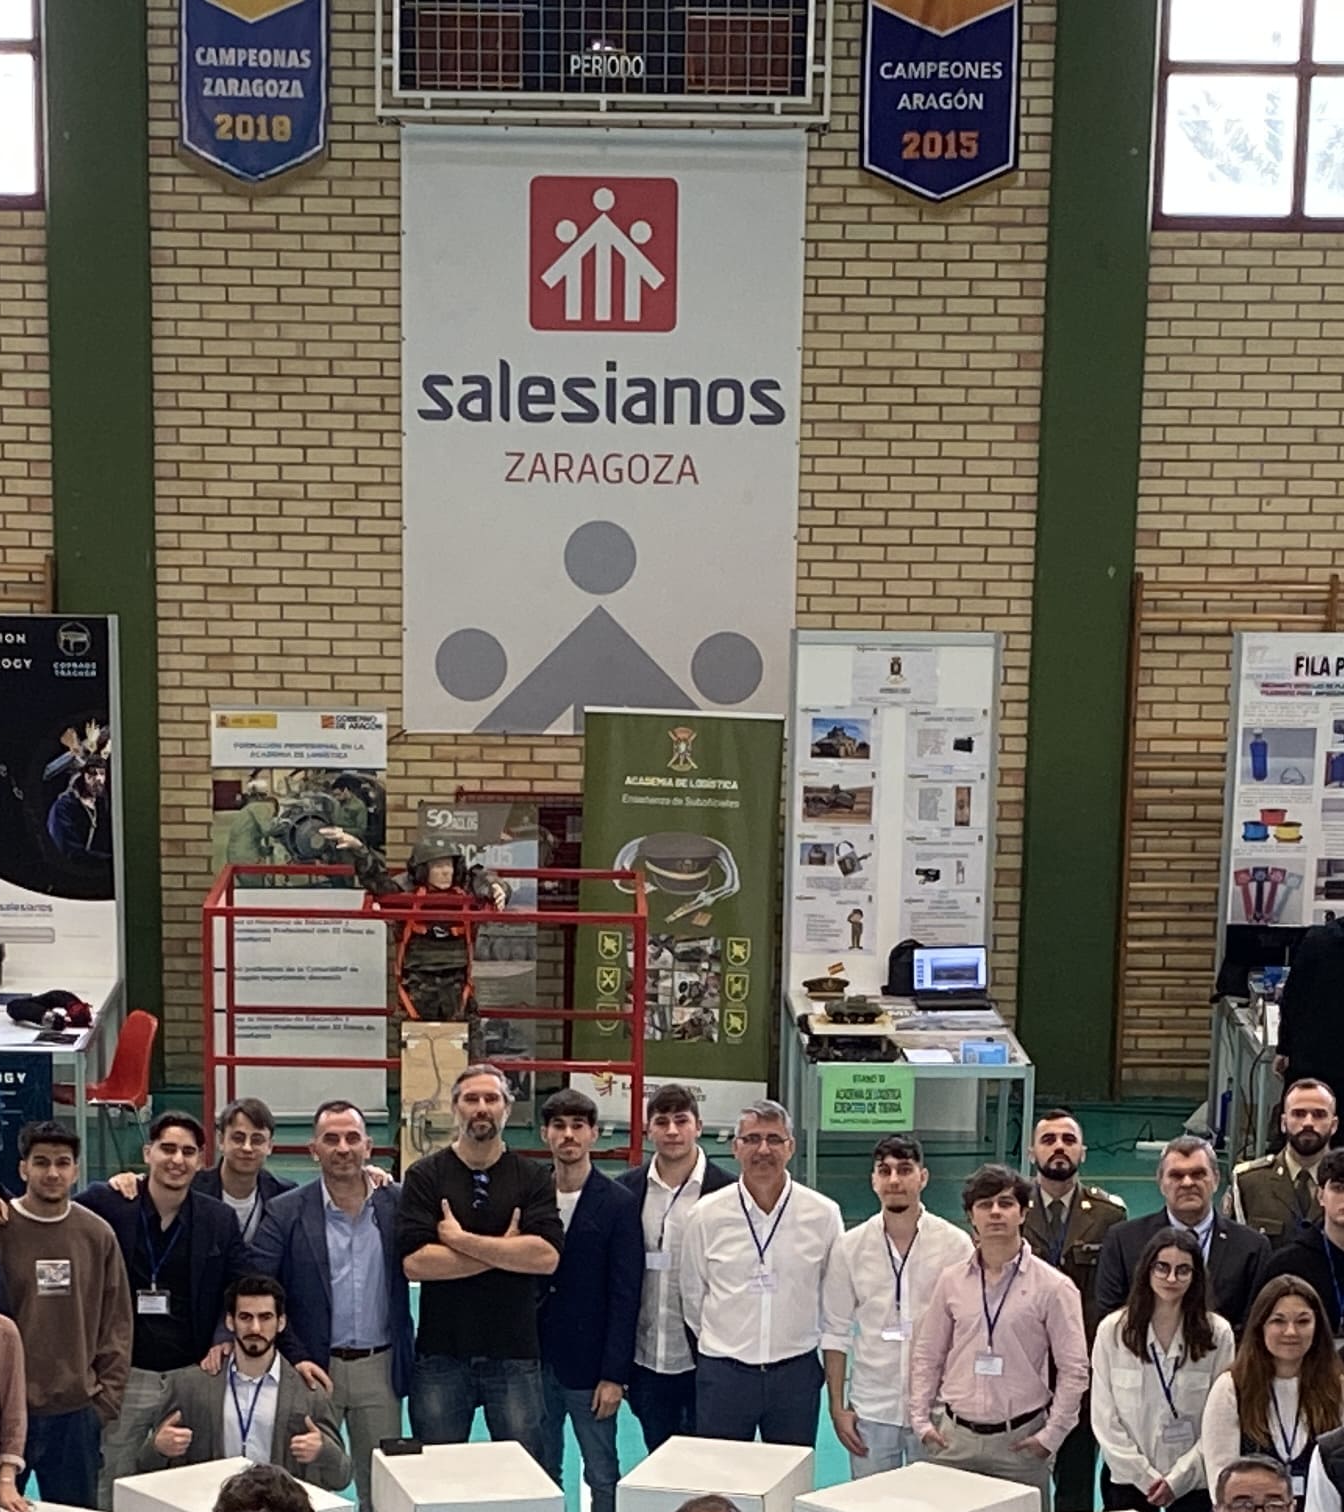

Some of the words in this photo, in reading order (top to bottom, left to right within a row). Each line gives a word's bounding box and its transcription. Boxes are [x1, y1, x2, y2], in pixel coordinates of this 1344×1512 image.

[195, 47, 311, 68] CAMPEONAS
[570, 55, 644, 78] PERIODO
[879, 61, 1003, 79] CAMPEONES
[202, 78, 304, 98] ZARAGOZA
[896, 88, 983, 110] ARAGÓN
[214, 113, 292, 142] 2018
[901, 131, 979, 159] 2015
[417, 359, 786, 427] salesianos
[504, 451, 700, 486] ZARAGOZA
[1294, 655, 1331, 677] FILA
[624, 776, 674, 787] ACADEMIA
[675, 777, 688, 788] DE
